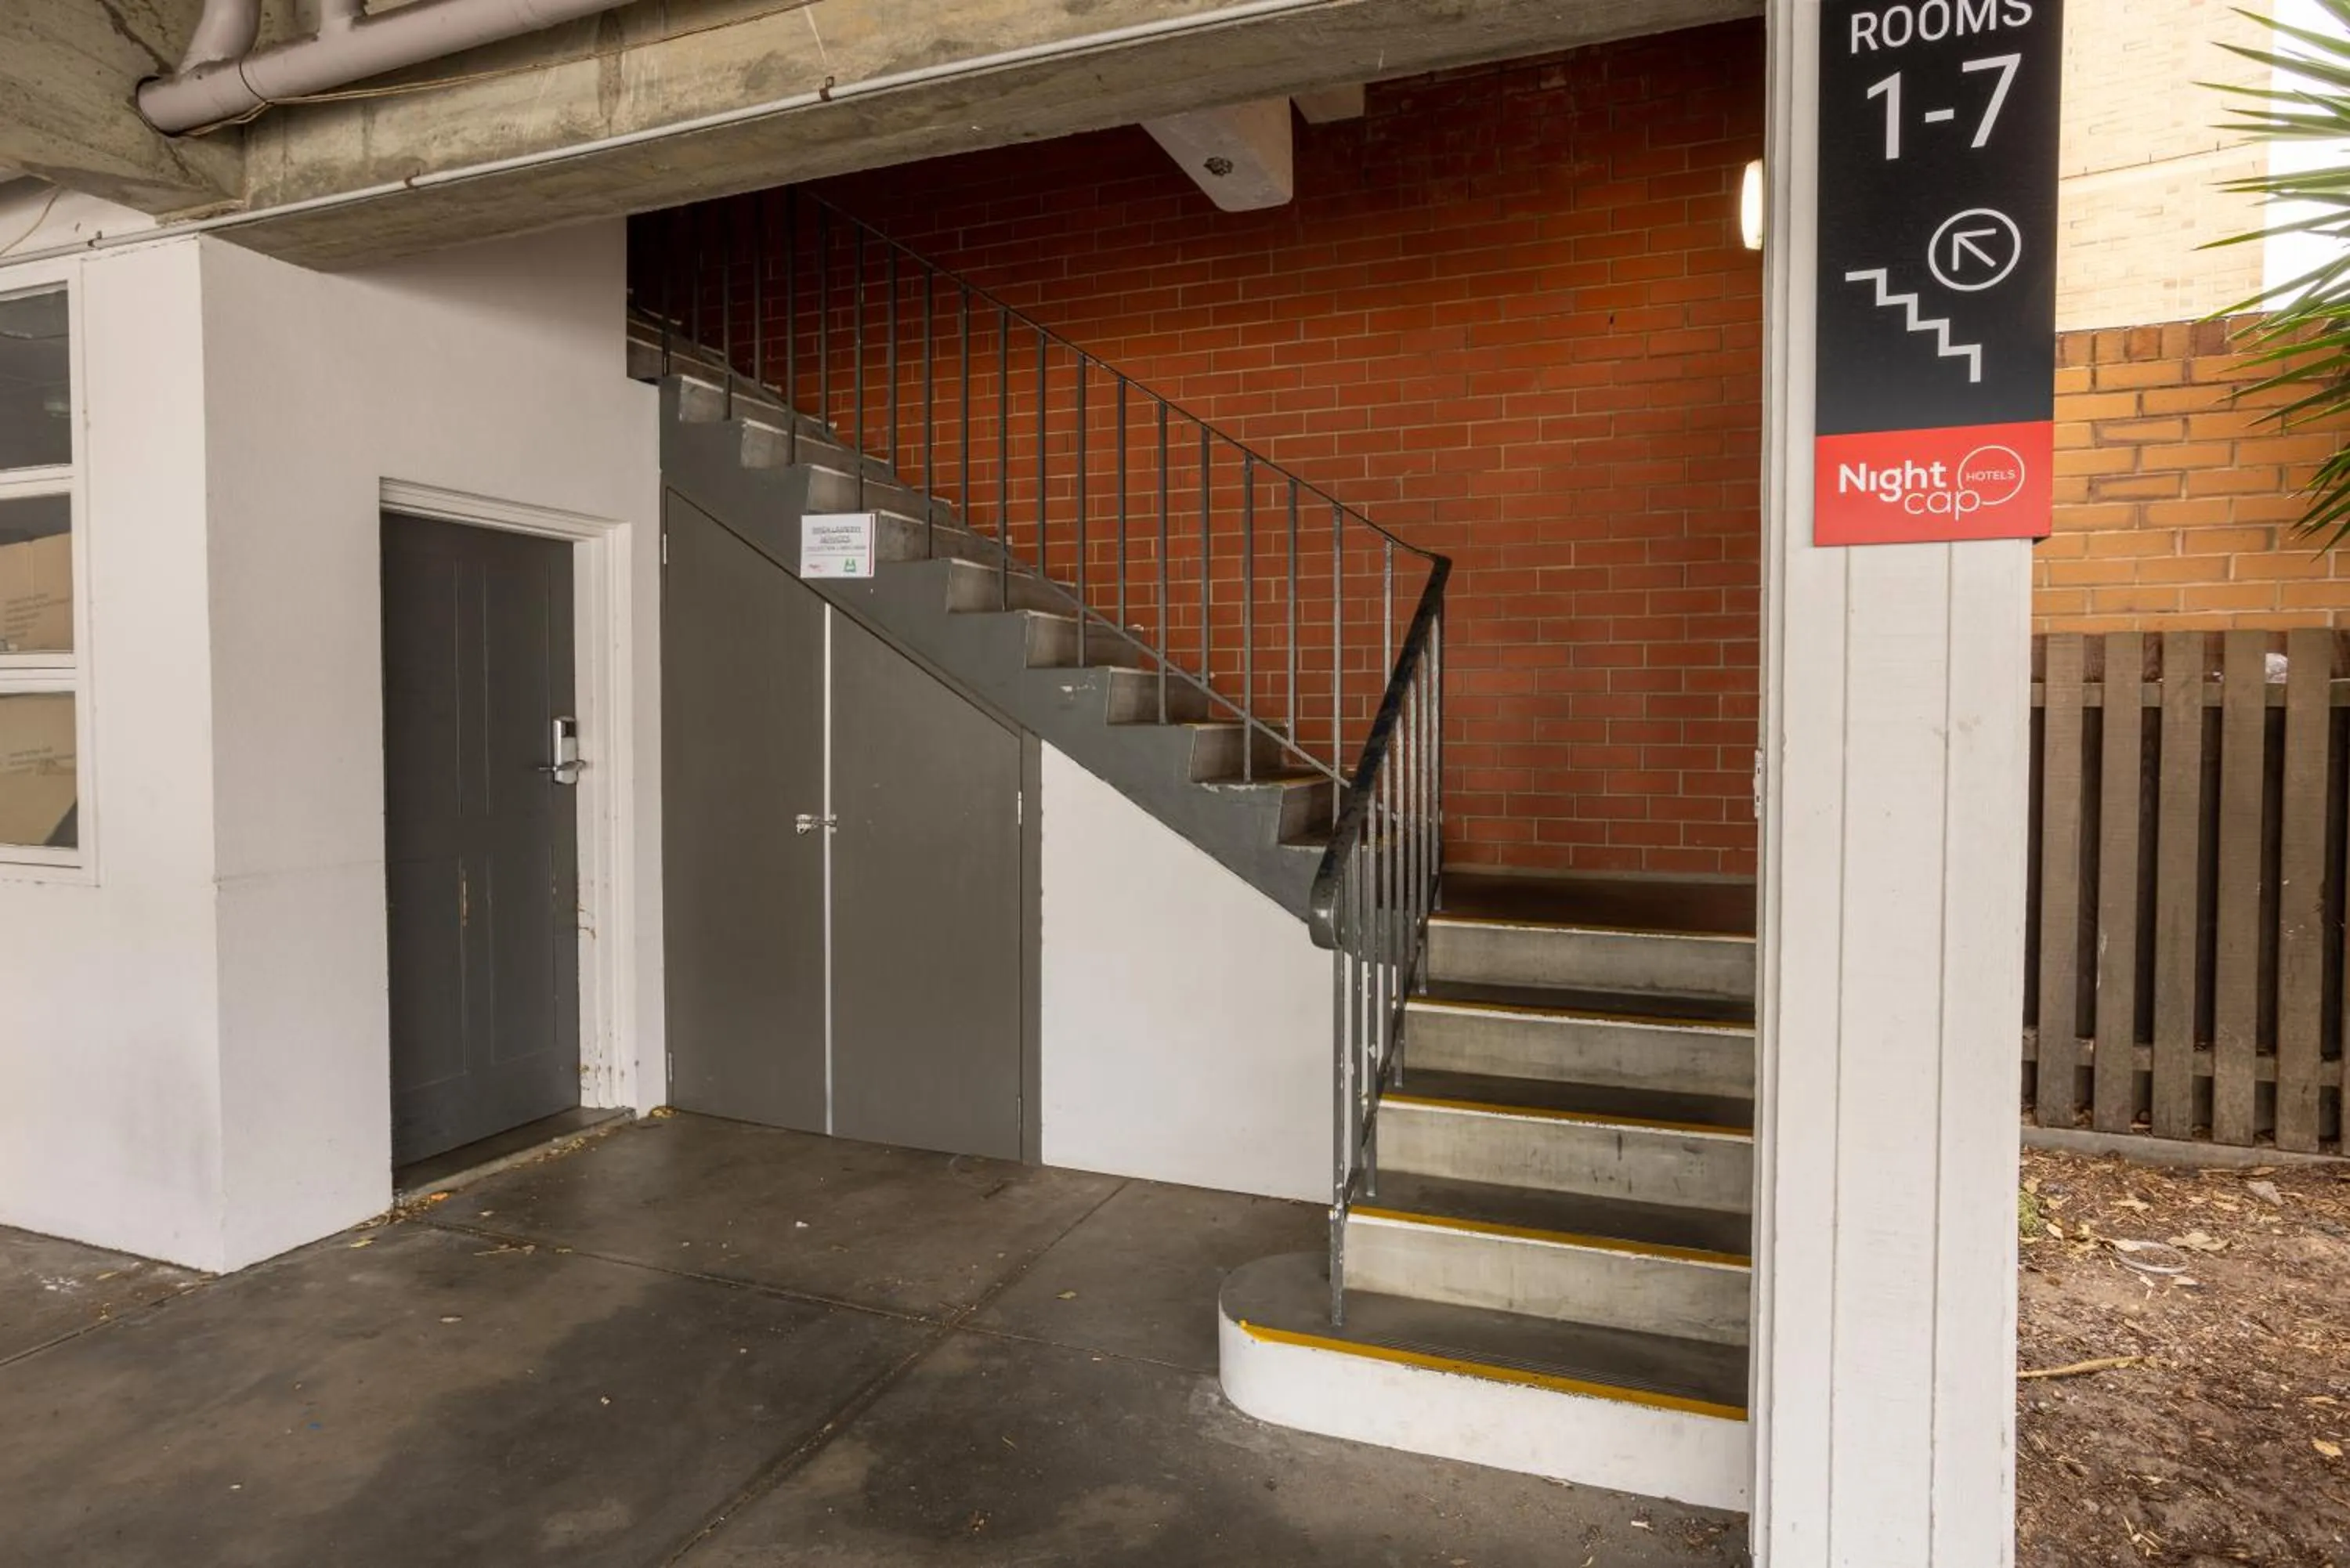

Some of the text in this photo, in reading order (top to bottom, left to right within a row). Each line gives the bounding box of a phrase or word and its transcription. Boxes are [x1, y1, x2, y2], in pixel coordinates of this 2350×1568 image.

[1851, 0, 2033, 54] ROOMS
[1867, 52, 2022, 161] 1-7
[1839, 460, 1947, 502] Night
[1965, 469, 2016, 481] HOTELS
[1904, 490, 1981, 521] cap
